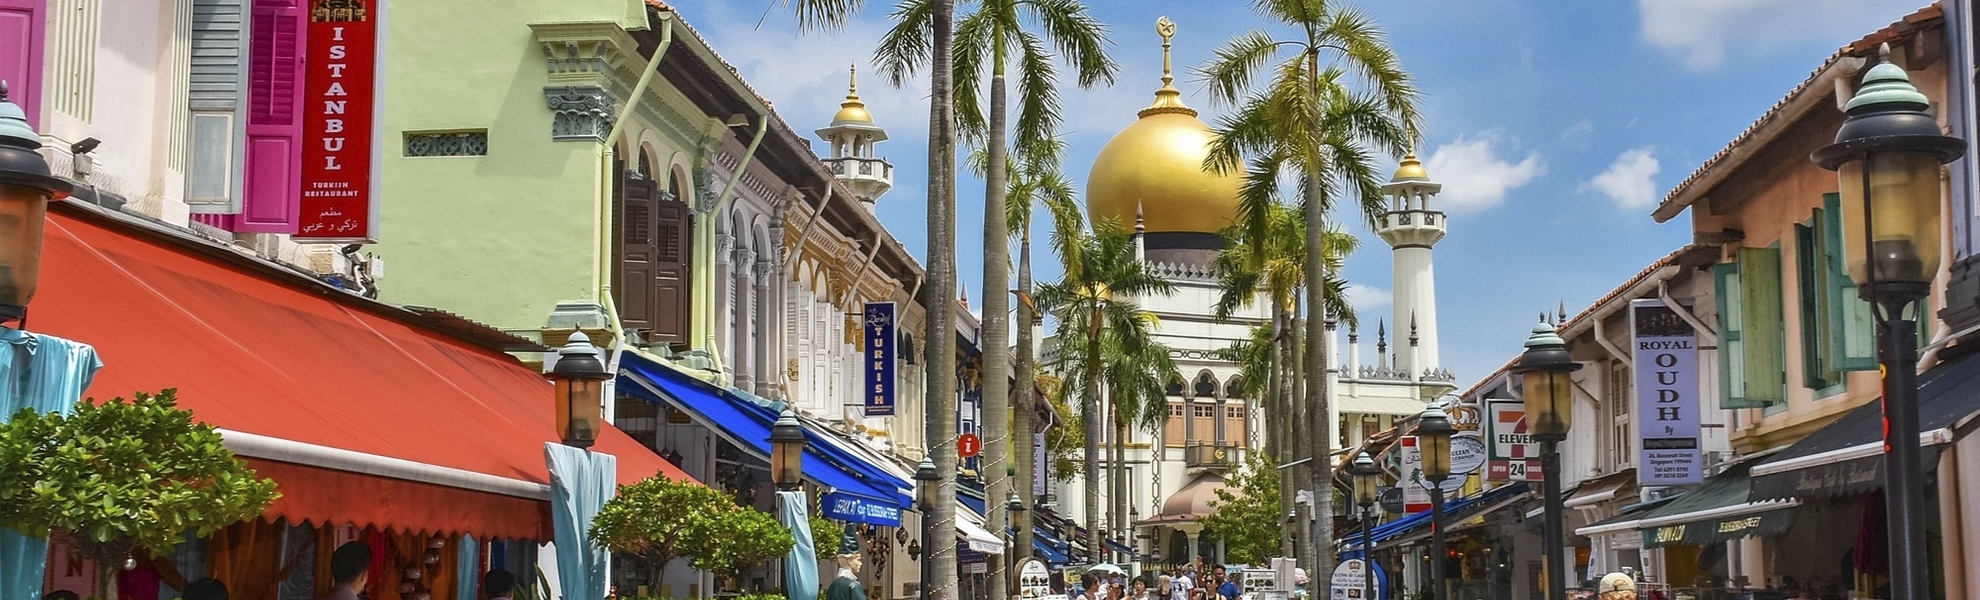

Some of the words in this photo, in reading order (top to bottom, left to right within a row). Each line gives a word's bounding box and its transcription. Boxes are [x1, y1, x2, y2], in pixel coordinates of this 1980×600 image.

[323, 27, 347, 170] ISTANBUL
[319, 207, 342, 219] مطعم
[303, 222, 324, 233] عربي
[337, 218, 358, 232] تركي
[1639, 341, 1692, 350] ROYAL
[874, 327, 883, 404] TURKISH
[1655, 353, 1681, 421] OUDH
[1665, 425, 1673, 435] By
[1451, 449, 1469, 457] ULTAN
[1510, 463, 1525, 476] 24
